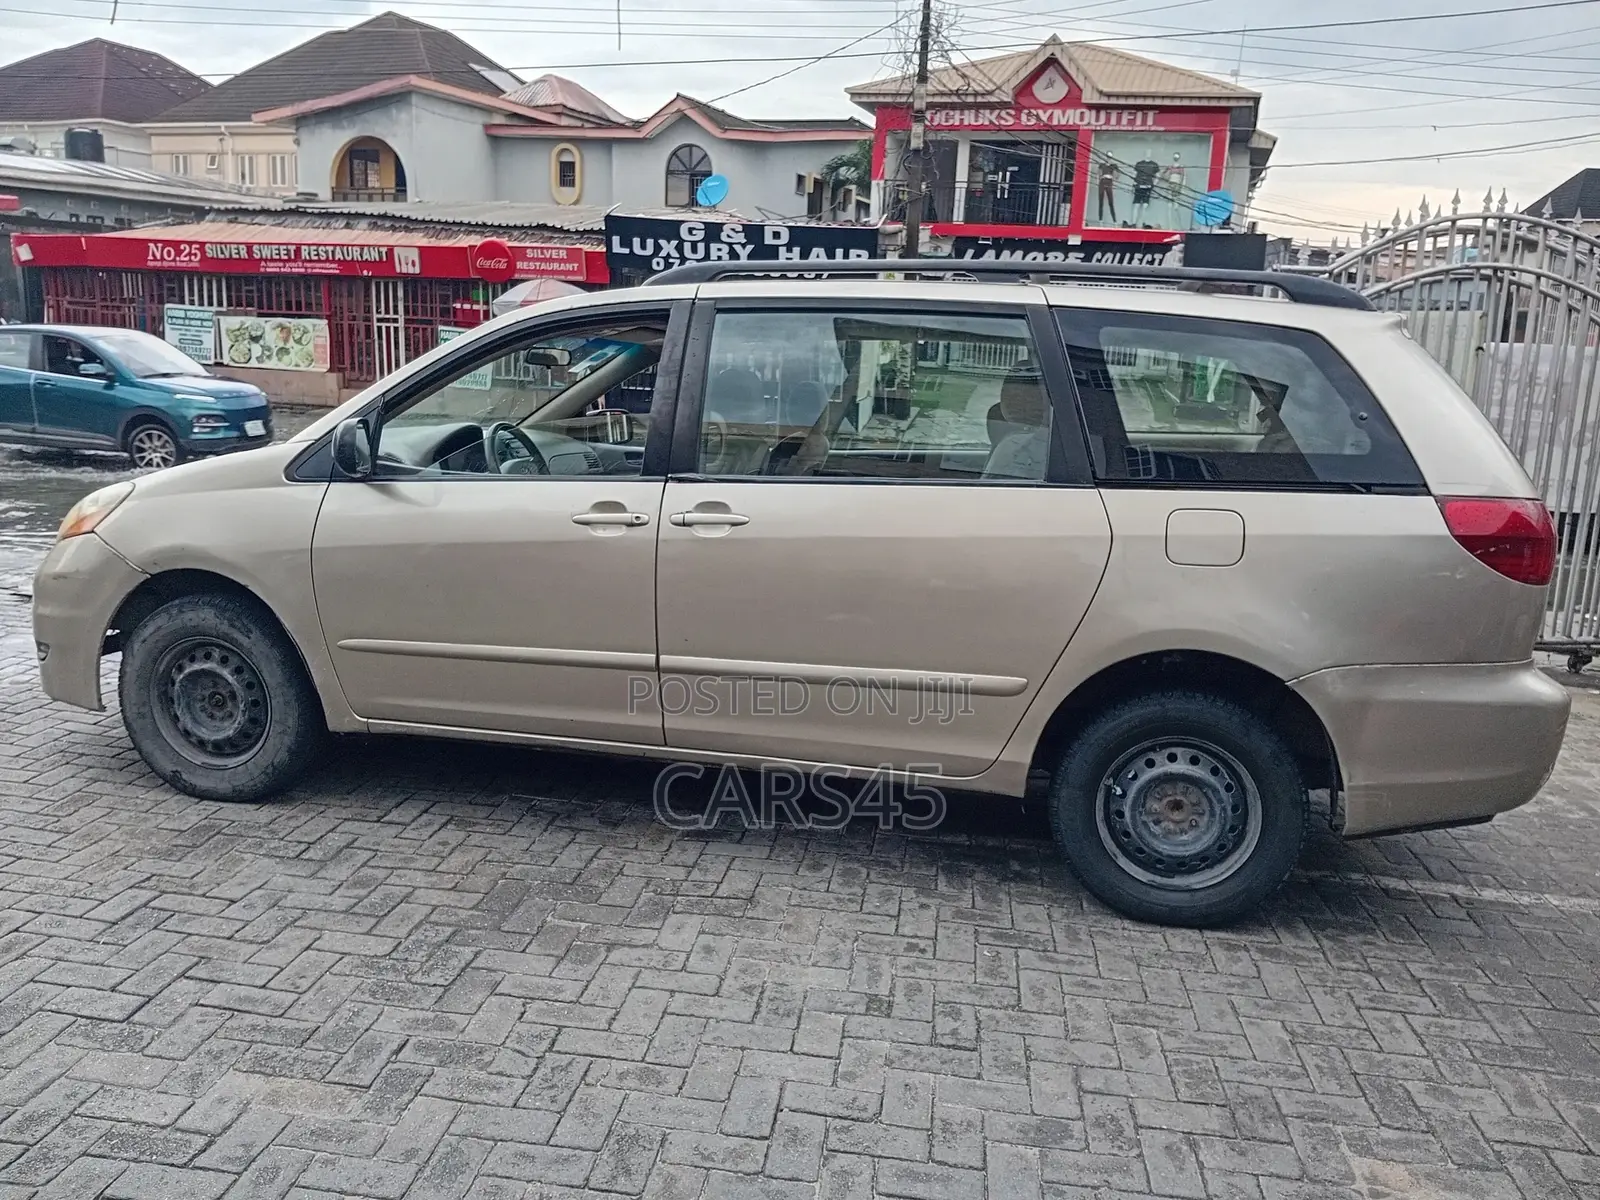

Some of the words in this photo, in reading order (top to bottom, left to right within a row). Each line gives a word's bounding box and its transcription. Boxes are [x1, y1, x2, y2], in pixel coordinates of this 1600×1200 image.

[679, 221, 706, 242] G
[720, 223, 748, 244] &
[763, 225, 790, 246] D
[147, 243, 202, 262] No.25
[204, 243, 249, 259] SILVER
[253, 244, 296, 260] SWEET
[300, 245, 388, 262] RESTAURANT
[526, 248, 568, 259] SILVER
[611, 235, 756, 261] LUXURY
[516, 261, 580, 272] RESTAURANT
